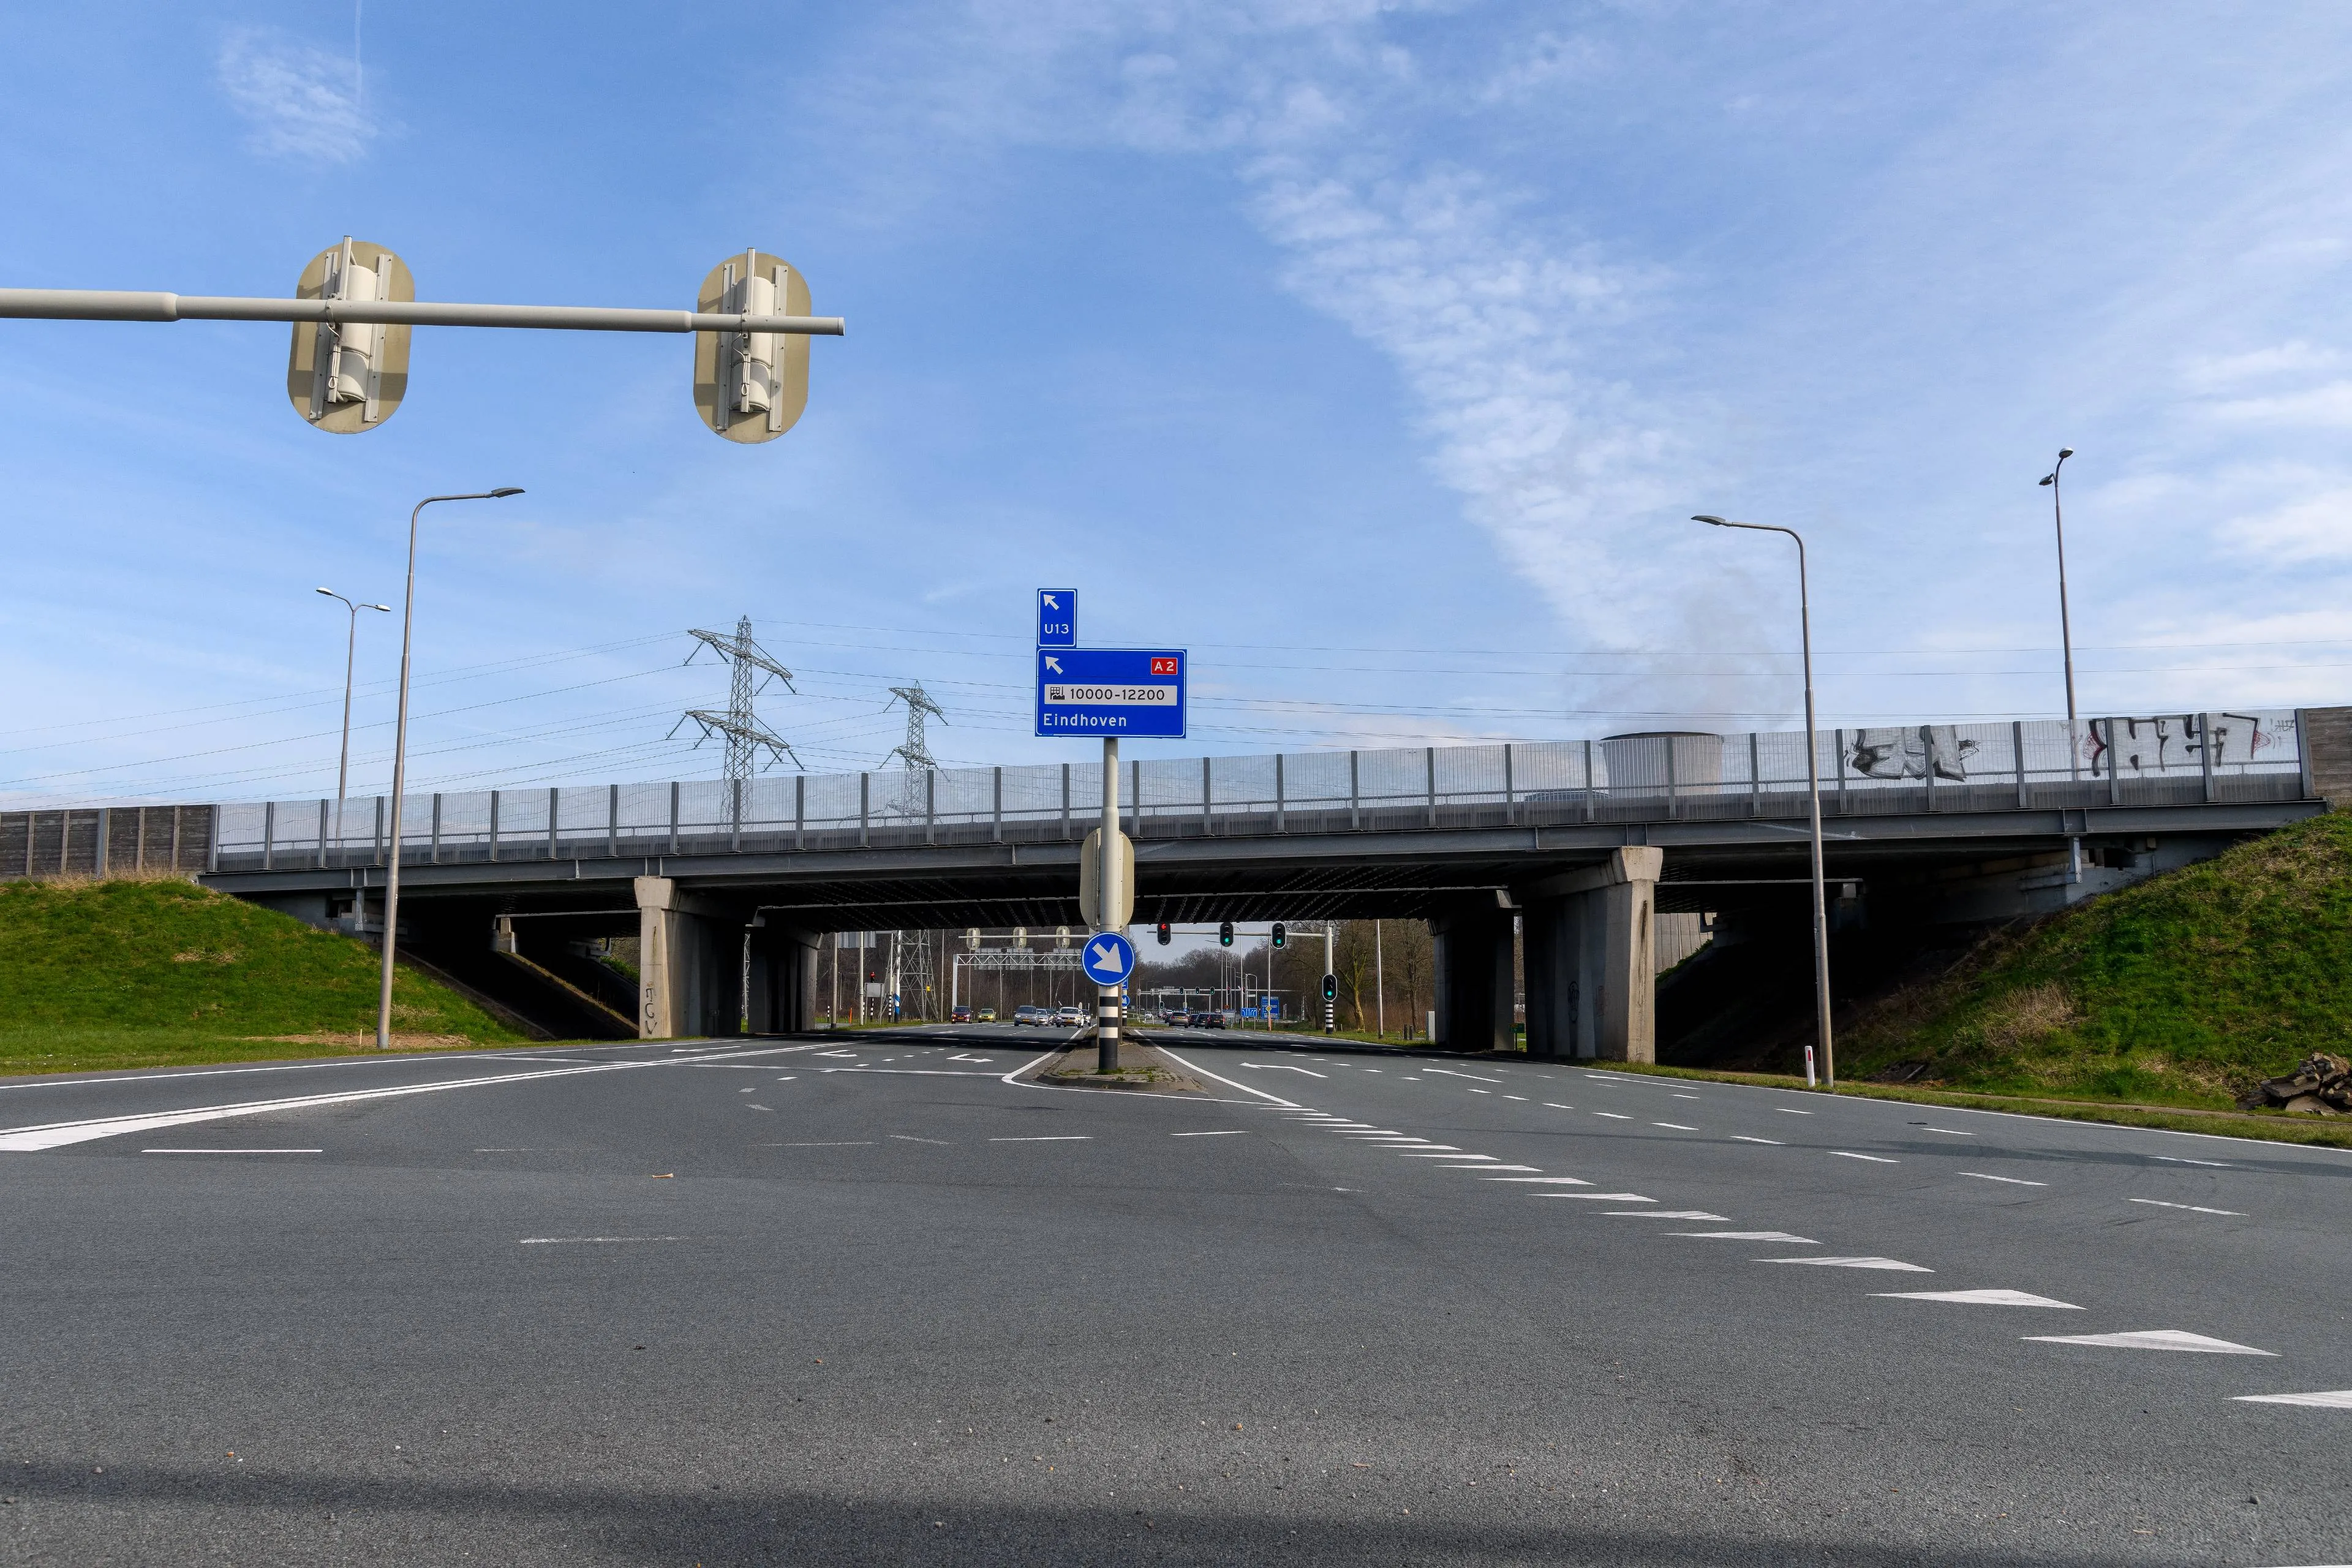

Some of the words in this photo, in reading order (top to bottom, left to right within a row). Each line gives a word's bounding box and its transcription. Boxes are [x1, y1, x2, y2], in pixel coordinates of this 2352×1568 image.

[1044, 624, 1069, 634] U13
[1070, 688, 1165, 700] 10000-12200
[1043, 714, 1127, 726] Eindhoven
